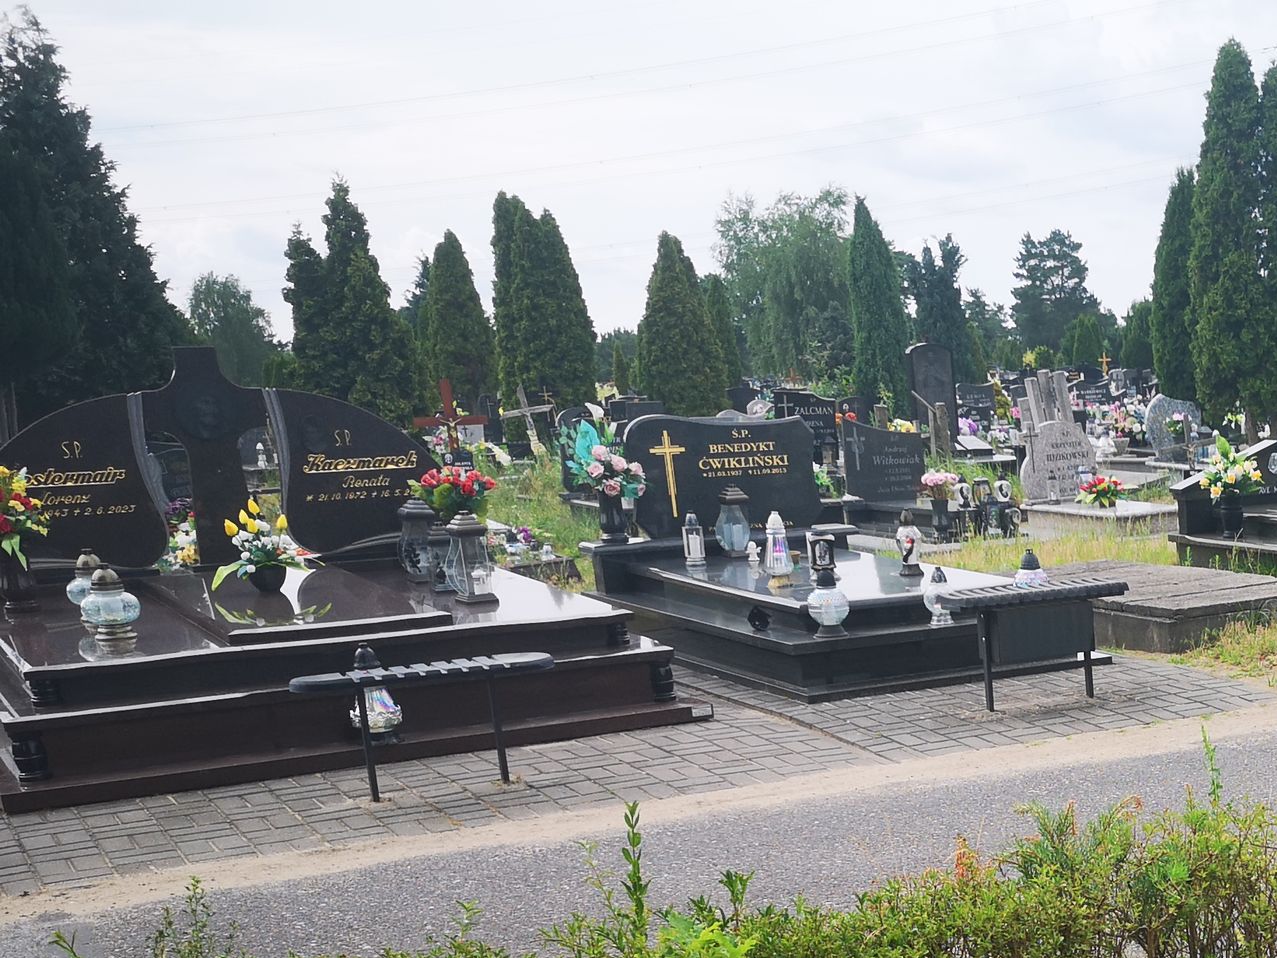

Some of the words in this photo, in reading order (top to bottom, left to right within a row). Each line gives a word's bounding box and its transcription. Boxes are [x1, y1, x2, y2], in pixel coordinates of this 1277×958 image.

[794, 407, 833, 415] ZALCMAN
[731, 428, 751, 439] Ś.P.
[709, 441, 776, 454] BENEDYKT
[303, 450, 418, 474] Kaczmarek
[698, 453, 789, 470] ĆWIKLIŃSKI
[342, 474, 391, 488] Renata
